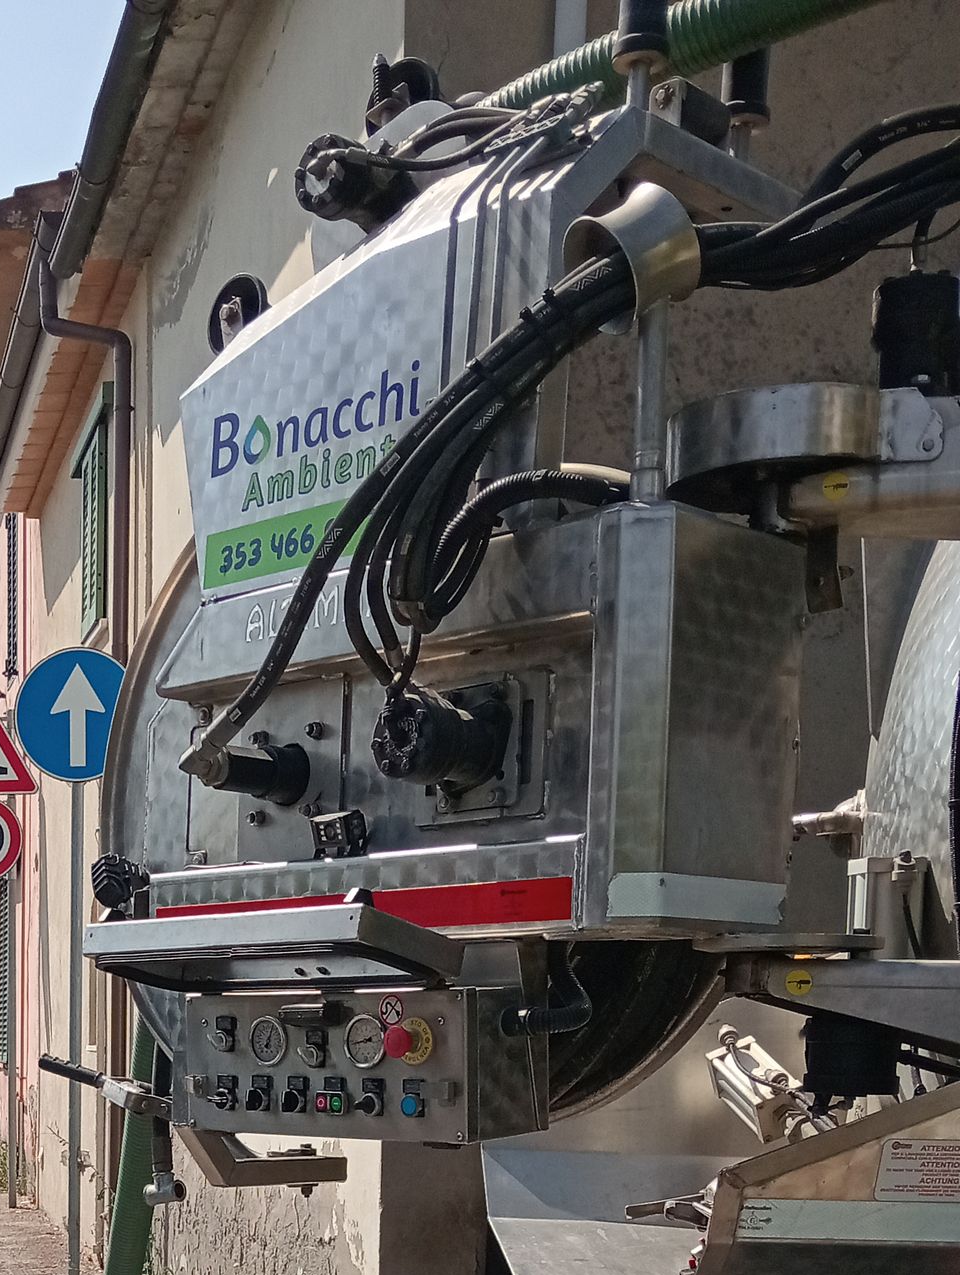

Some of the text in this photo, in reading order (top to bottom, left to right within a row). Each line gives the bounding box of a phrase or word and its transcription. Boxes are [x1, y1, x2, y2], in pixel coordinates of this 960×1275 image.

[211, 360, 420, 478] Bonacchi
[242, 433, 397, 512] Ambient
[219, 537, 262, 574] 353
[270, 523, 315, 560] 466
[919, 1177, 960, 1185] ACHTUNG
